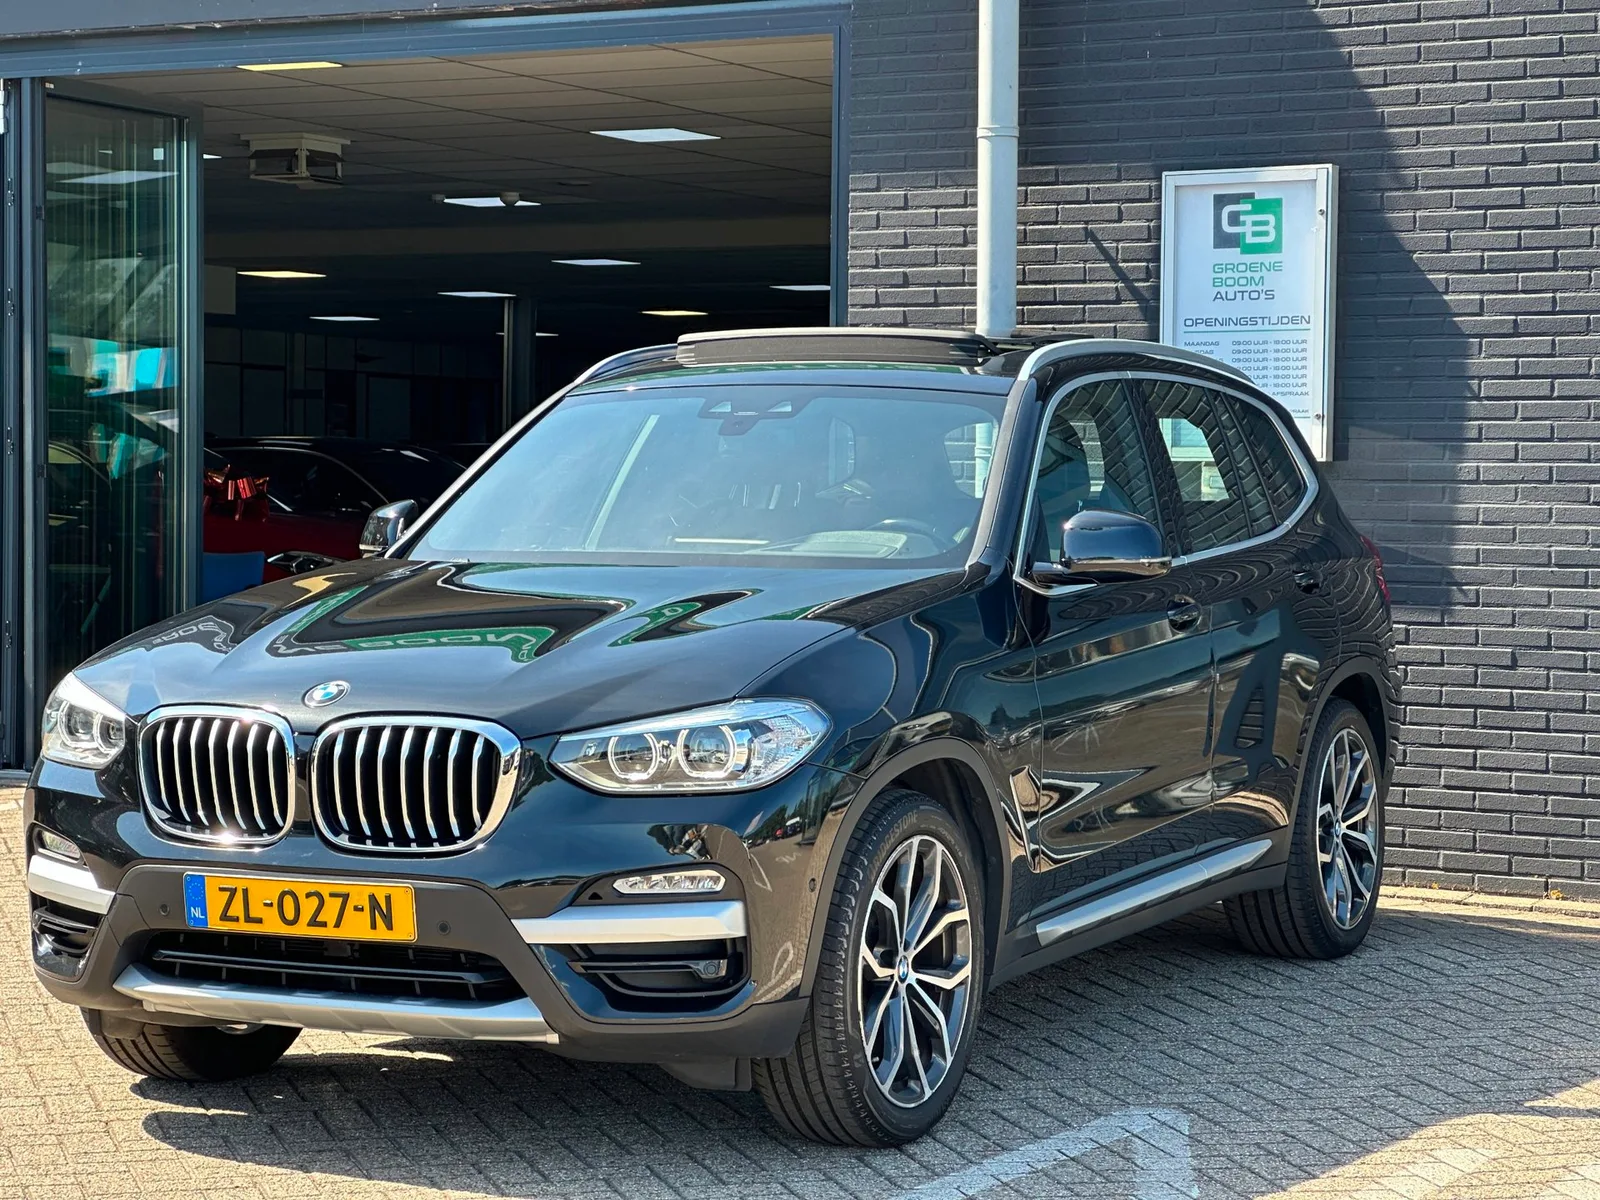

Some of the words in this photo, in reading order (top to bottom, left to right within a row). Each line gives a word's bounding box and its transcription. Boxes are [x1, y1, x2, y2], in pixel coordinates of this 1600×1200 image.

[1212, 261, 1283, 274] GROENE
[1212, 276, 1264, 287] BOOM
[1212, 289, 1275, 302] AUTO'S
[1183, 315, 1311, 327] OPENINGSTIJDEN
[190, 906, 205, 919] NL
[218, 885, 394, 931] ZL-027-N
